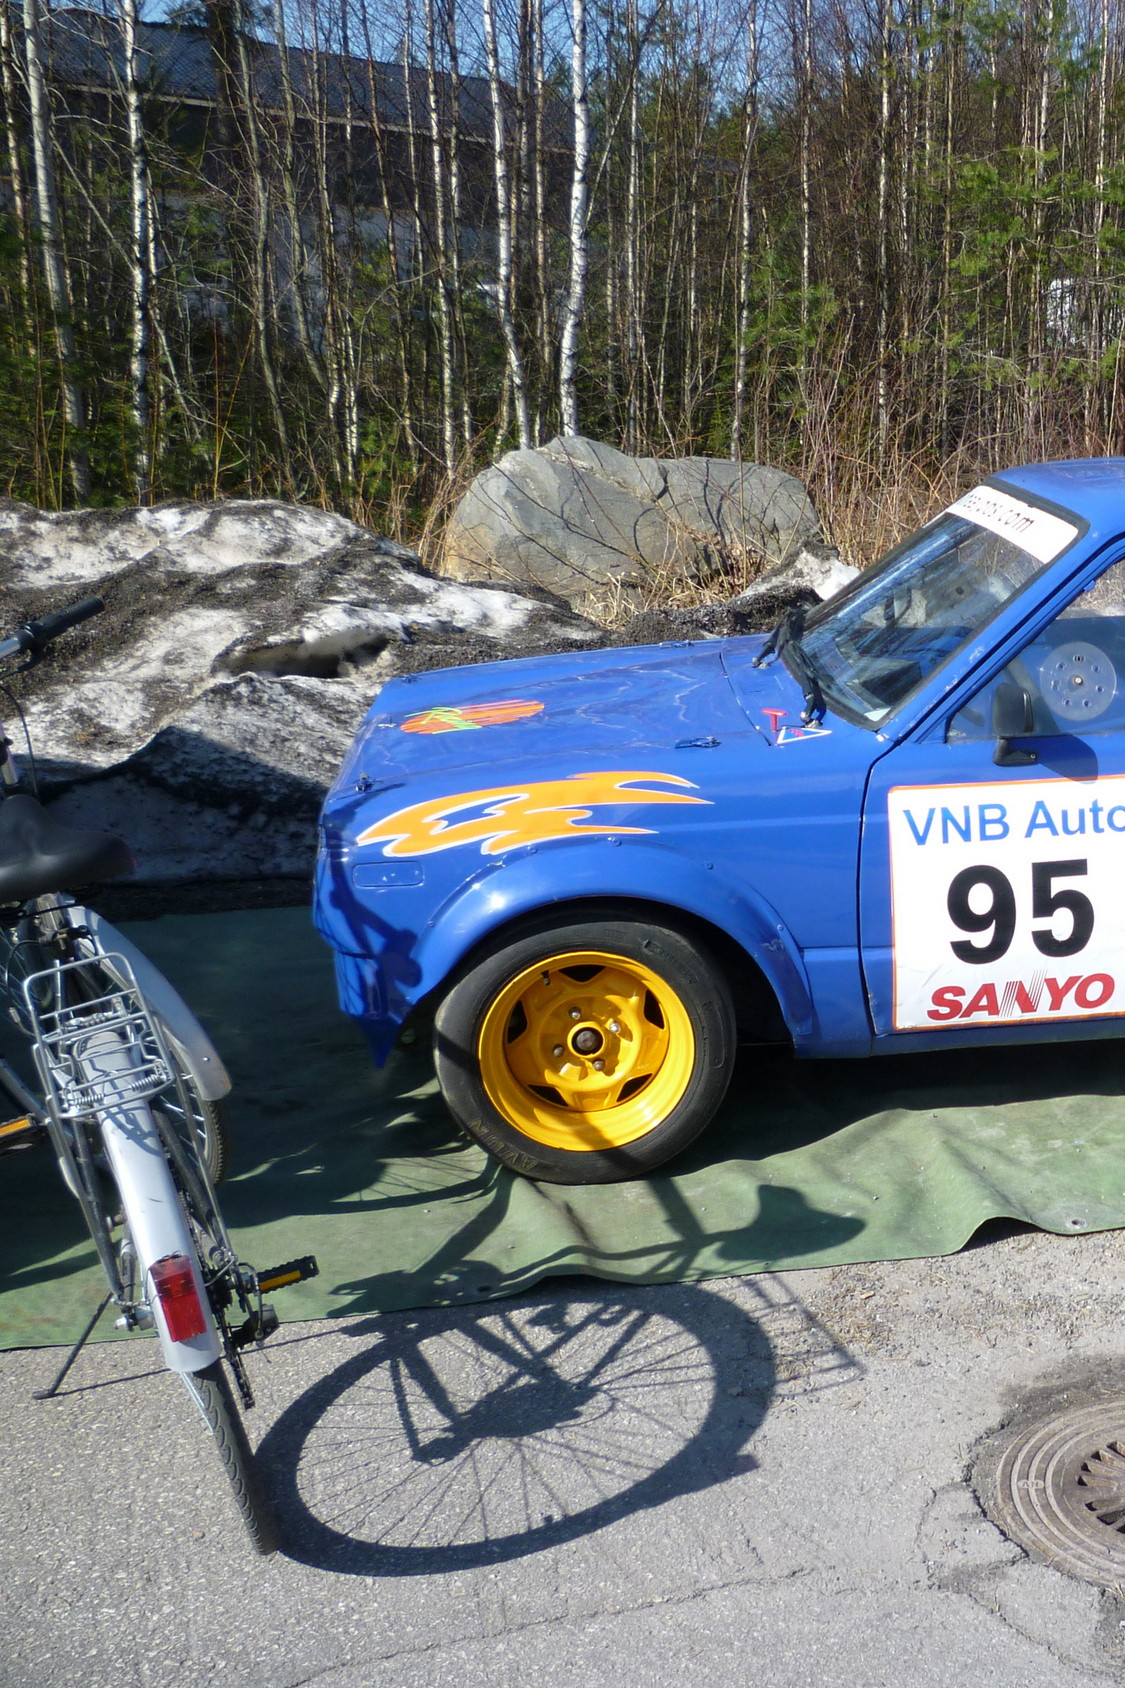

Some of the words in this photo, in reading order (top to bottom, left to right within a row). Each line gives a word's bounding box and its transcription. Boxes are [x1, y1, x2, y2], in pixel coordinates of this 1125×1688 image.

[903, 804, 1010, 846] VNB
[947, 858, 1095, 965] 95
[927, 969, 1115, 1021] SANYO
